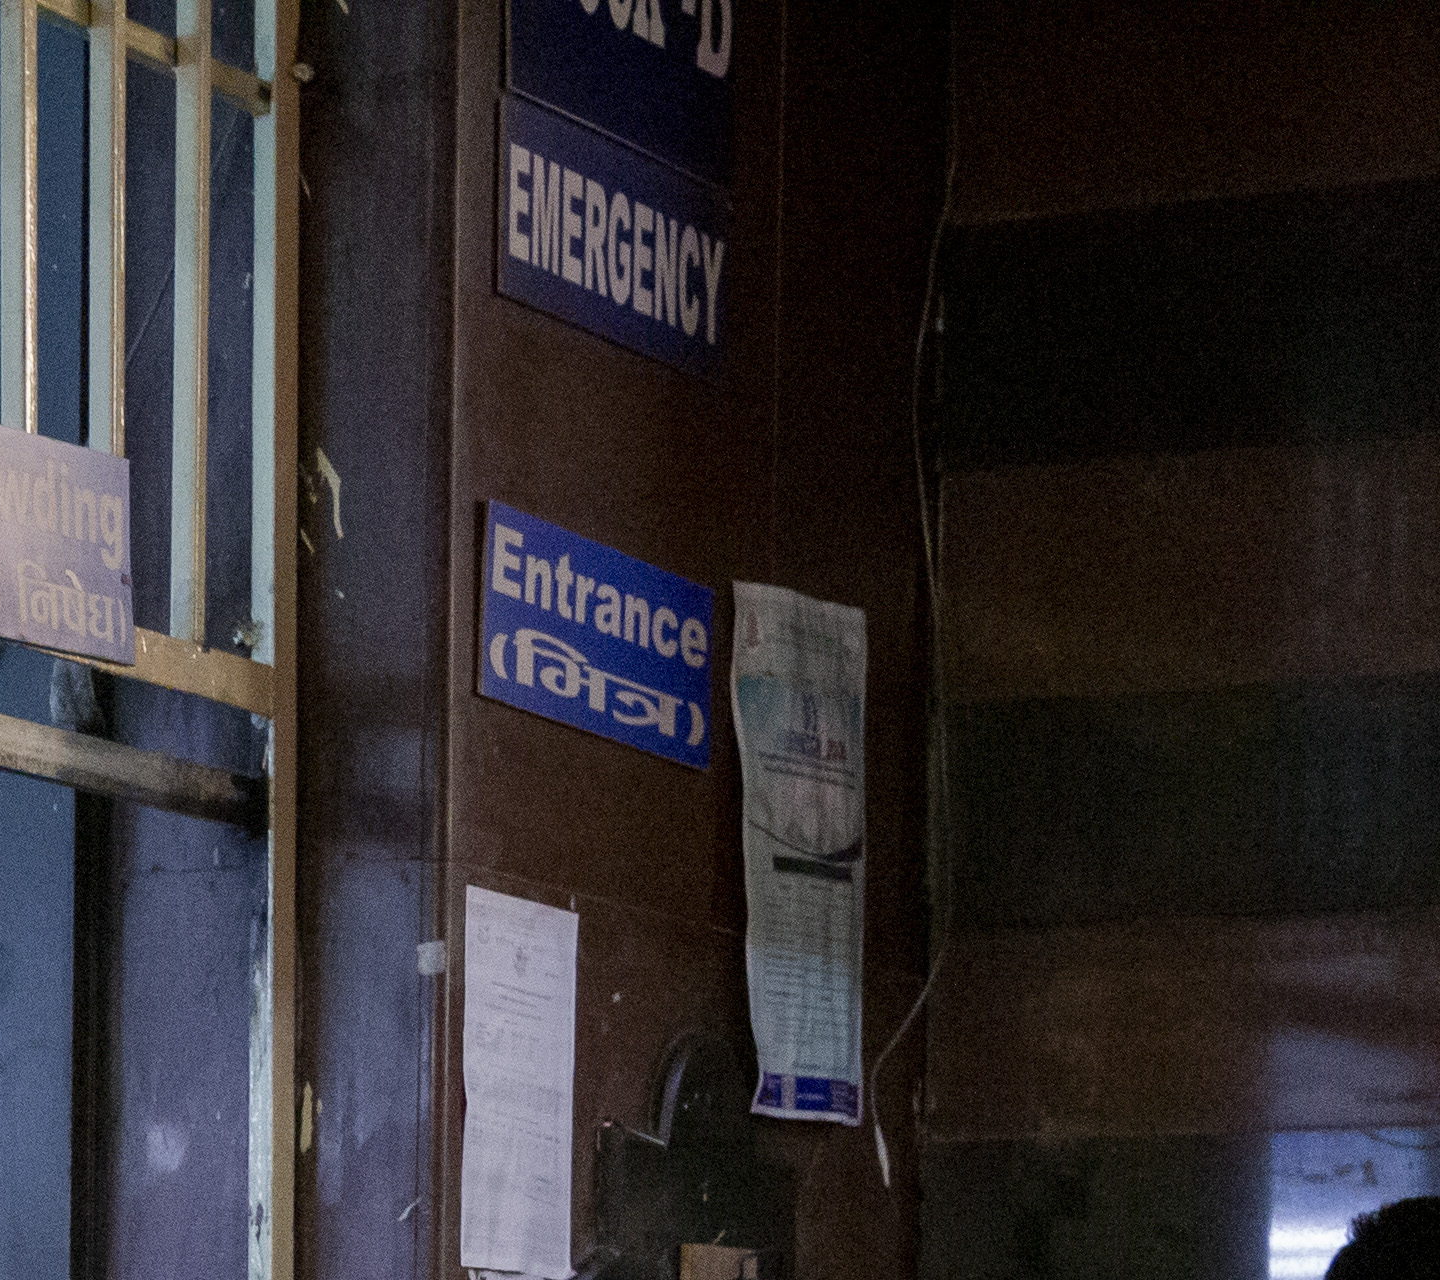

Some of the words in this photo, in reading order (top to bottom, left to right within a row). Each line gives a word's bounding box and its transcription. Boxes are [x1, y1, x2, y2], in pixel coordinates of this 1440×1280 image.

[508, 142, 724, 345] EMERGENCY
[492, 522, 707, 668] Entrance
[489, 628, 705, 746] (भित्र)
